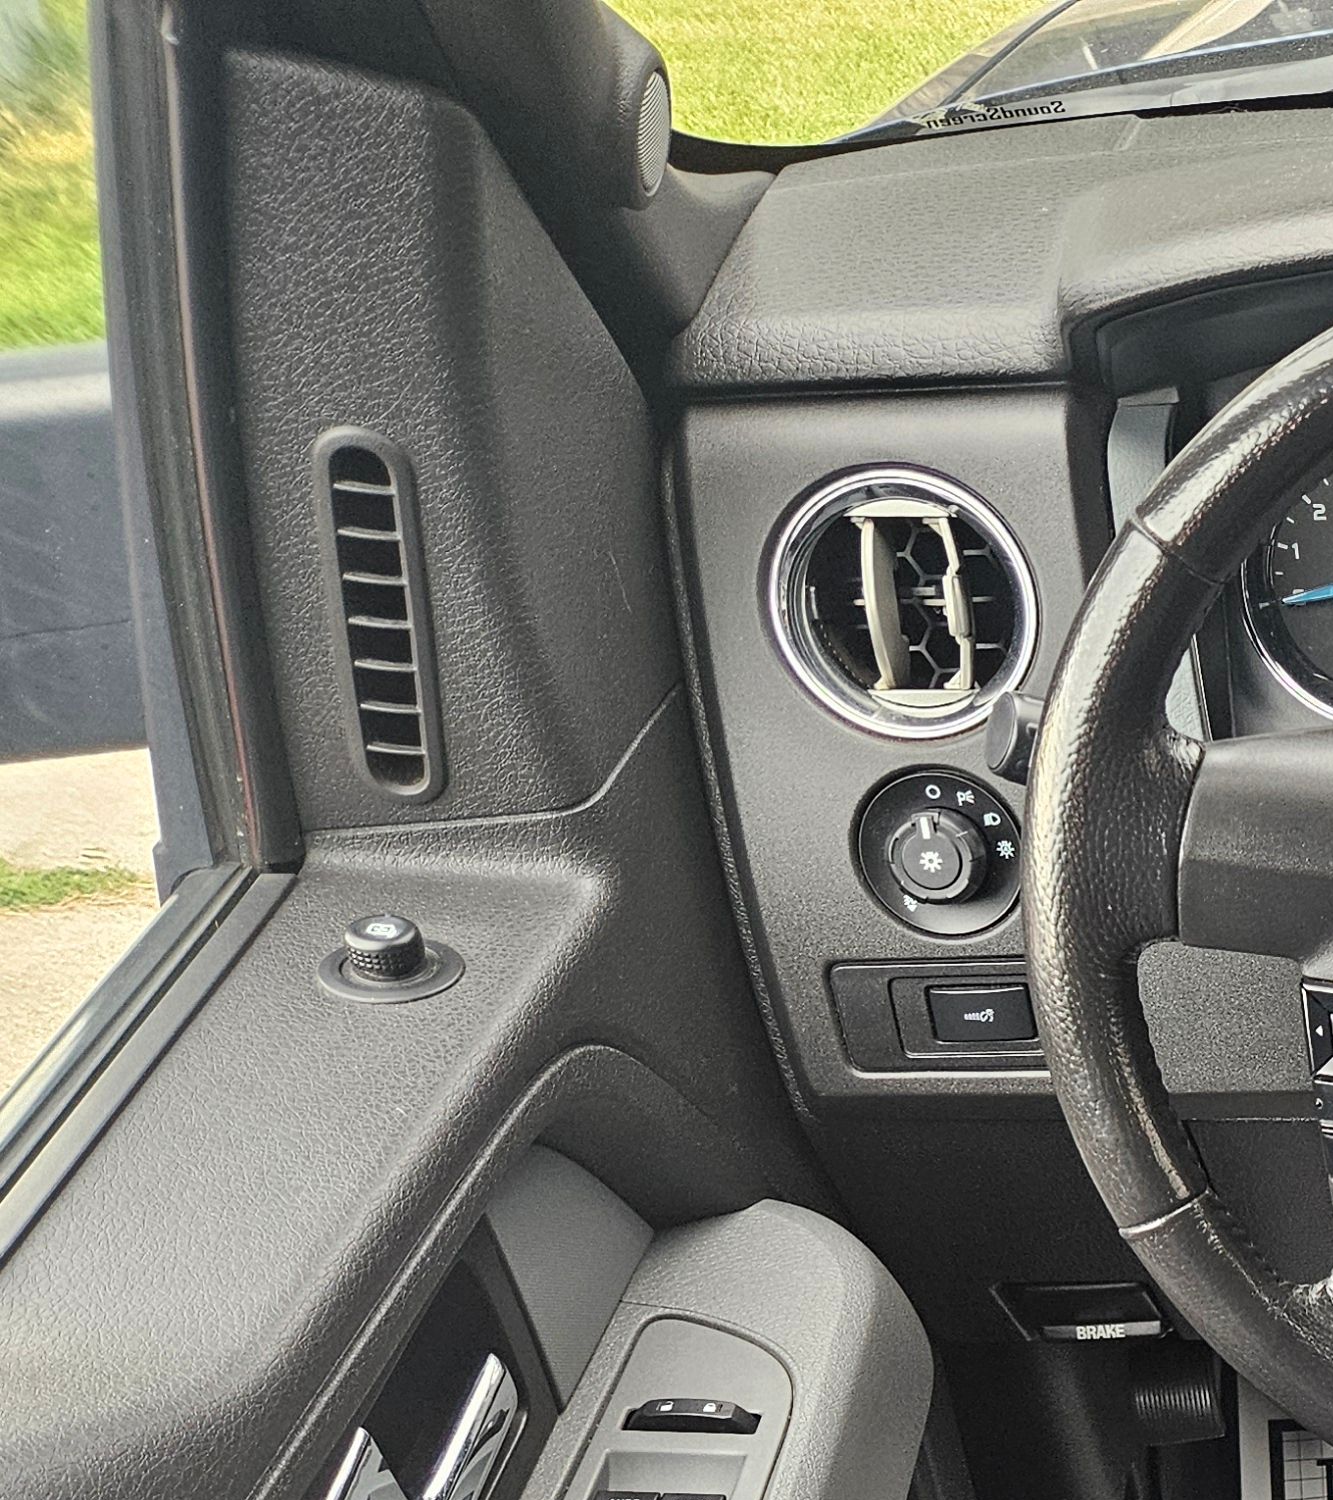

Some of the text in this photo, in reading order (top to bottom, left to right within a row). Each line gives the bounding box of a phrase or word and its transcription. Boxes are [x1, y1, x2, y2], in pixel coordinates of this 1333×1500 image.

[1312, 503, 1327, 521] 2
[1291, 542, 1300, 560] 1
[1075, 1324, 1126, 1340] BRAKE
